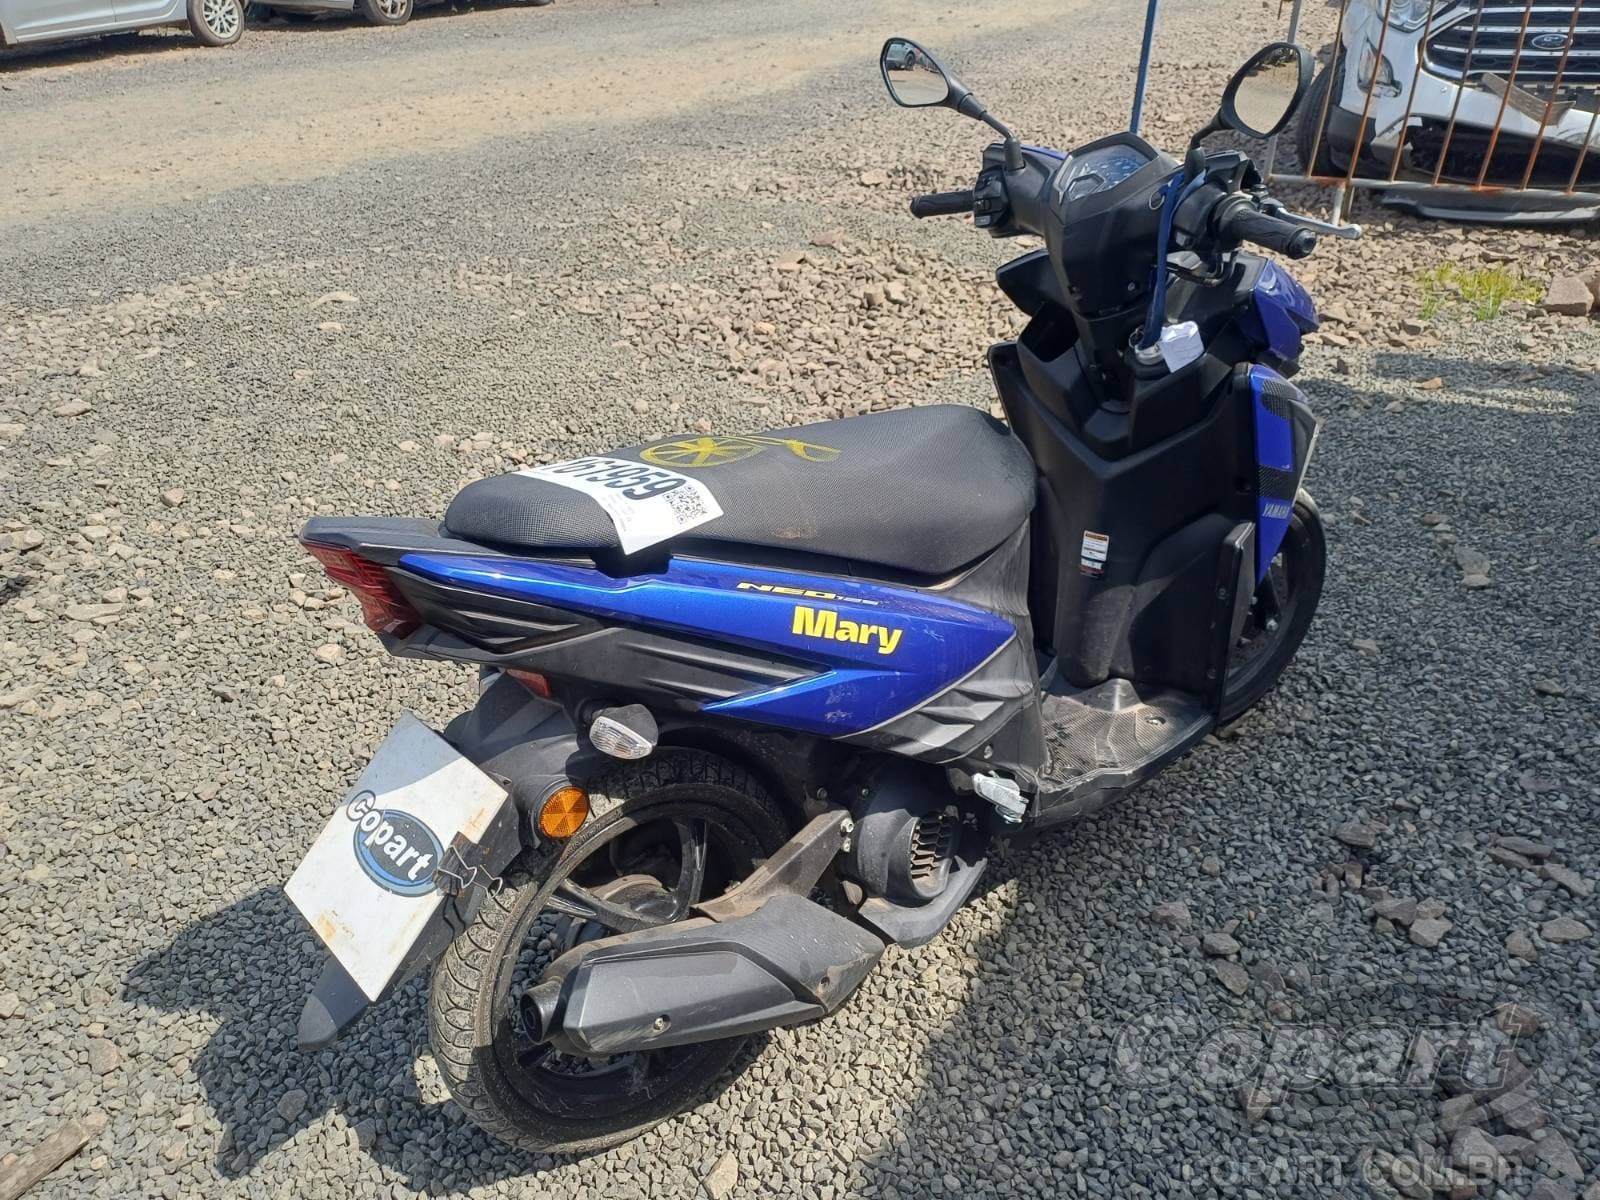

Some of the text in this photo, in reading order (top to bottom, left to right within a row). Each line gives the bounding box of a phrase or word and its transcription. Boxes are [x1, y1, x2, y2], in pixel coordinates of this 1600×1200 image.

[736, 582, 836, 599] NEO
[791, 605, 902, 655] Mary
[346, 789, 435, 881] Copart
